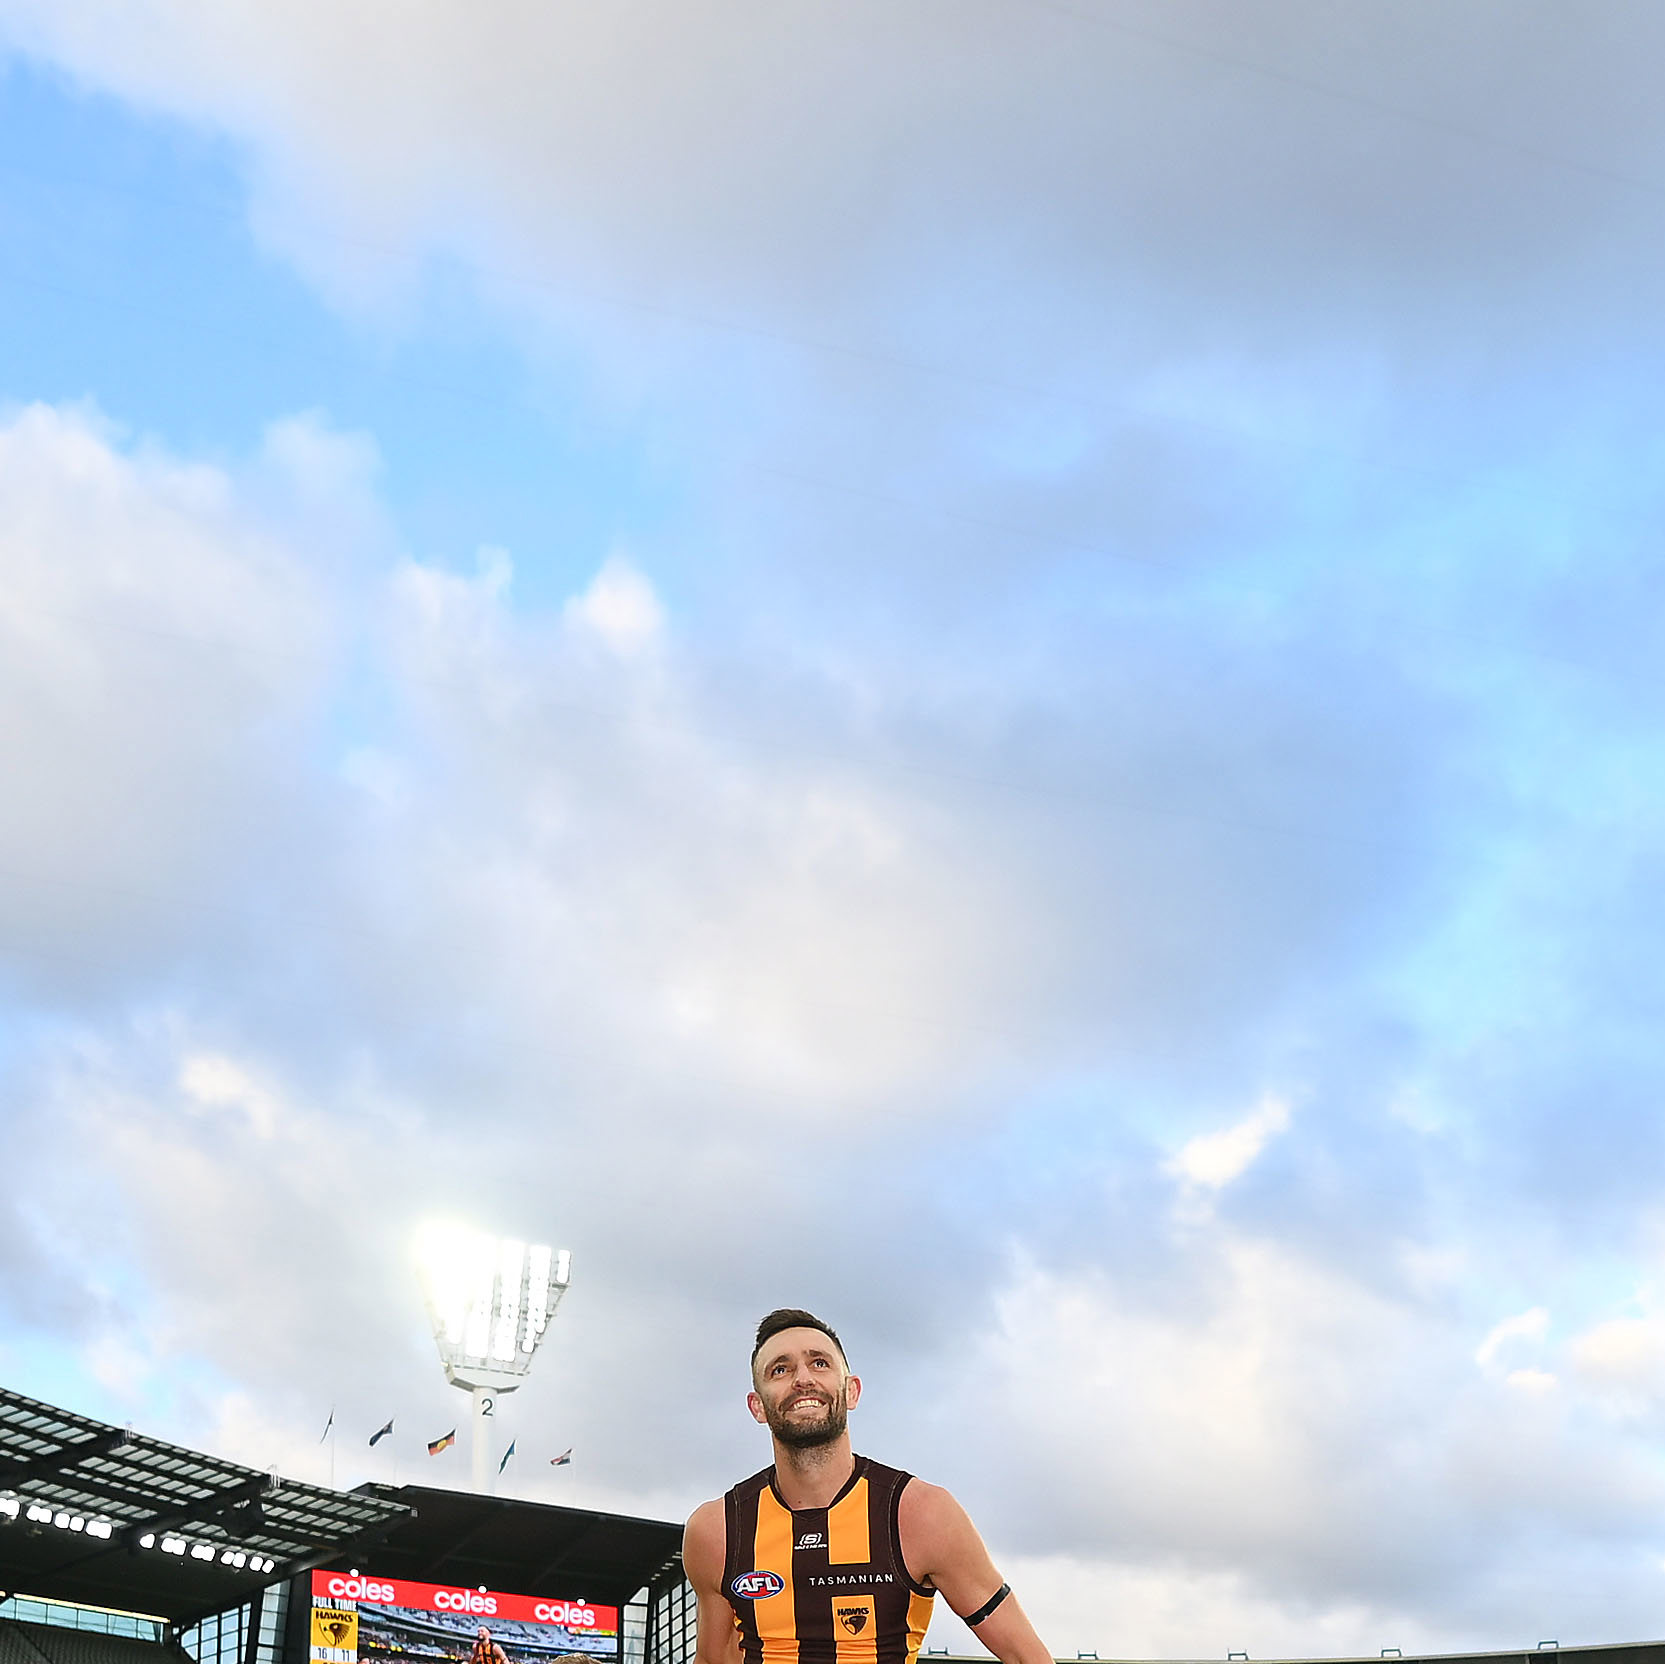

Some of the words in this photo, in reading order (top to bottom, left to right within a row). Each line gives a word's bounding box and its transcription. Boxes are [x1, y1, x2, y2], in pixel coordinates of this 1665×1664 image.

[481, 1398, 493, 1416] 2
[736, 1577, 780, 1593] AFL
[809, 1574, 894, 1586] TASMANIAN
[312, 1596, 333, 1609] FULL
[335, 1598, 357, 1612] TIME
[328, 1578, 395, 1602] coles
[434, 1590, 497, 1615] coles
[535, 1602, 596, 1627] coles
[315, 1610, 354, 1622] HAWKS
[837, 1607, 869, 1616] HAWKS
[317, 1647, 328, 1659] 16
[341, 1650, 350, 1661] 11
